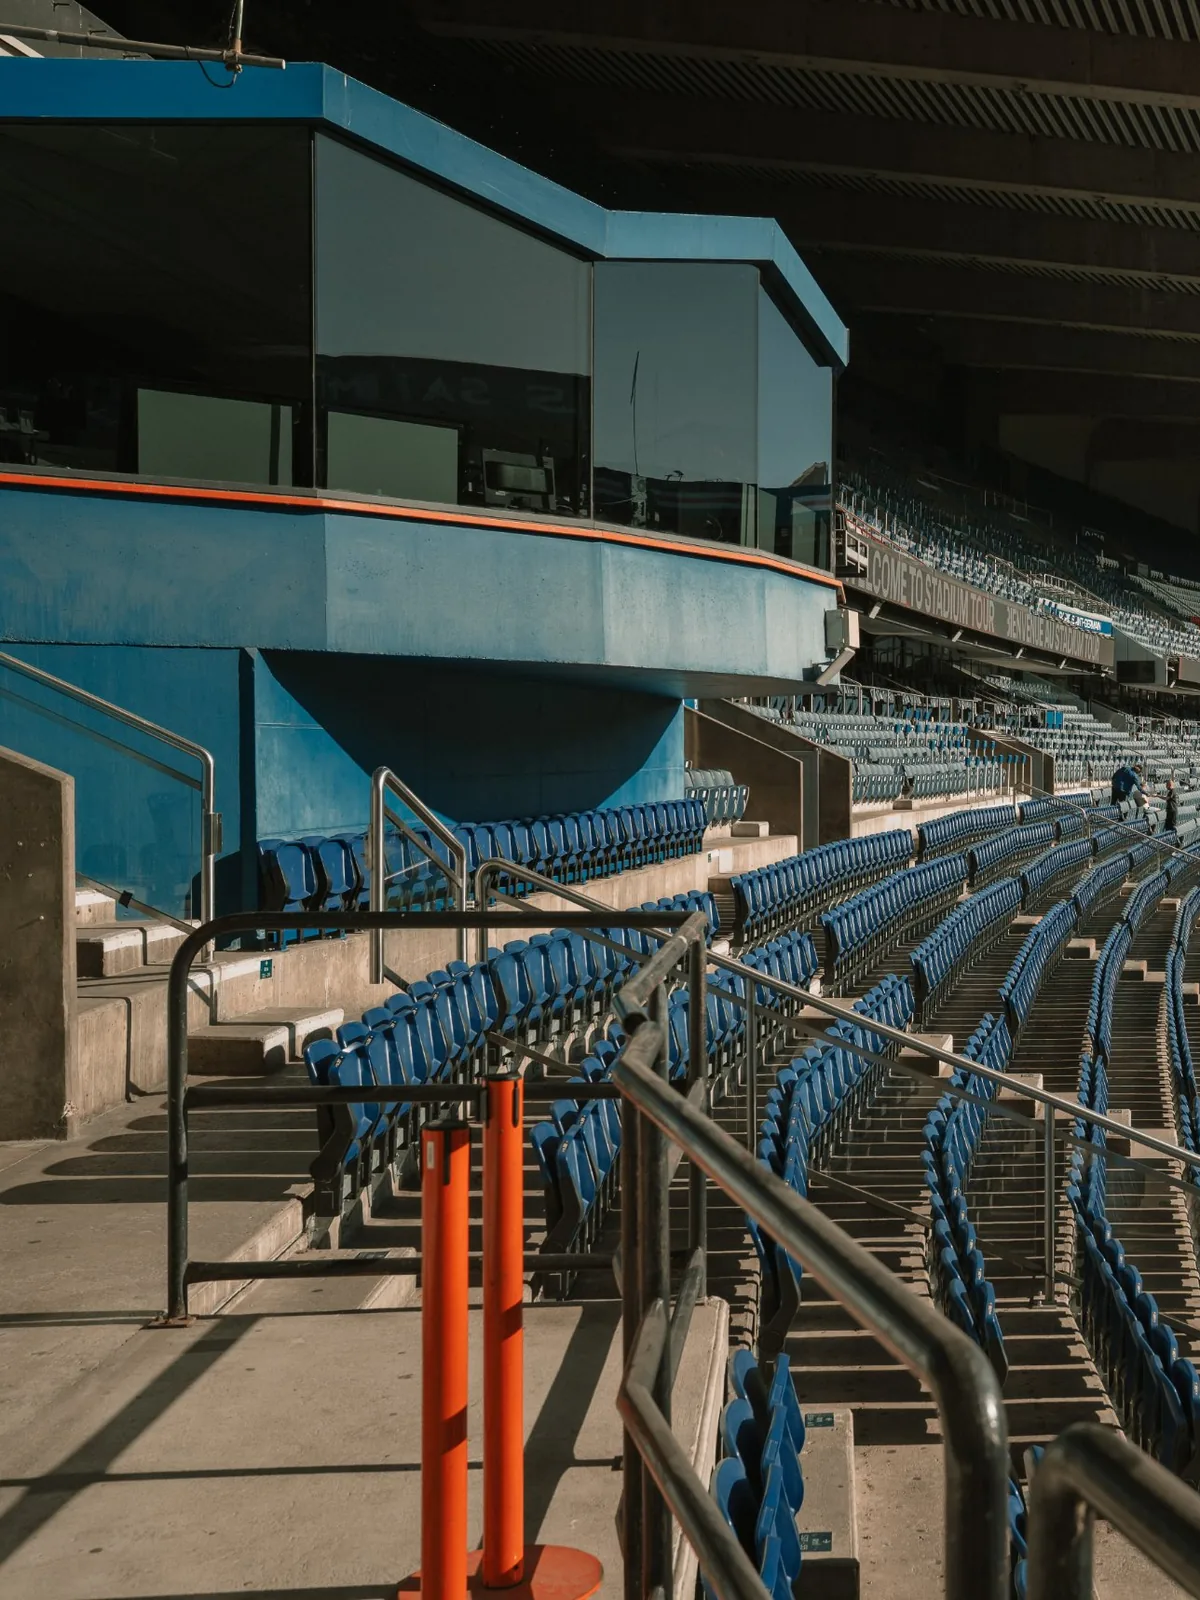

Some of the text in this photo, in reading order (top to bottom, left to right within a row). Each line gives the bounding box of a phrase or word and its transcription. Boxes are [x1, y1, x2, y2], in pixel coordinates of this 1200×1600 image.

[908, 566, 923, 610] TO
[925, 573, 969, 625] STADIUM
[971, 593, 995, 633] TOUR
